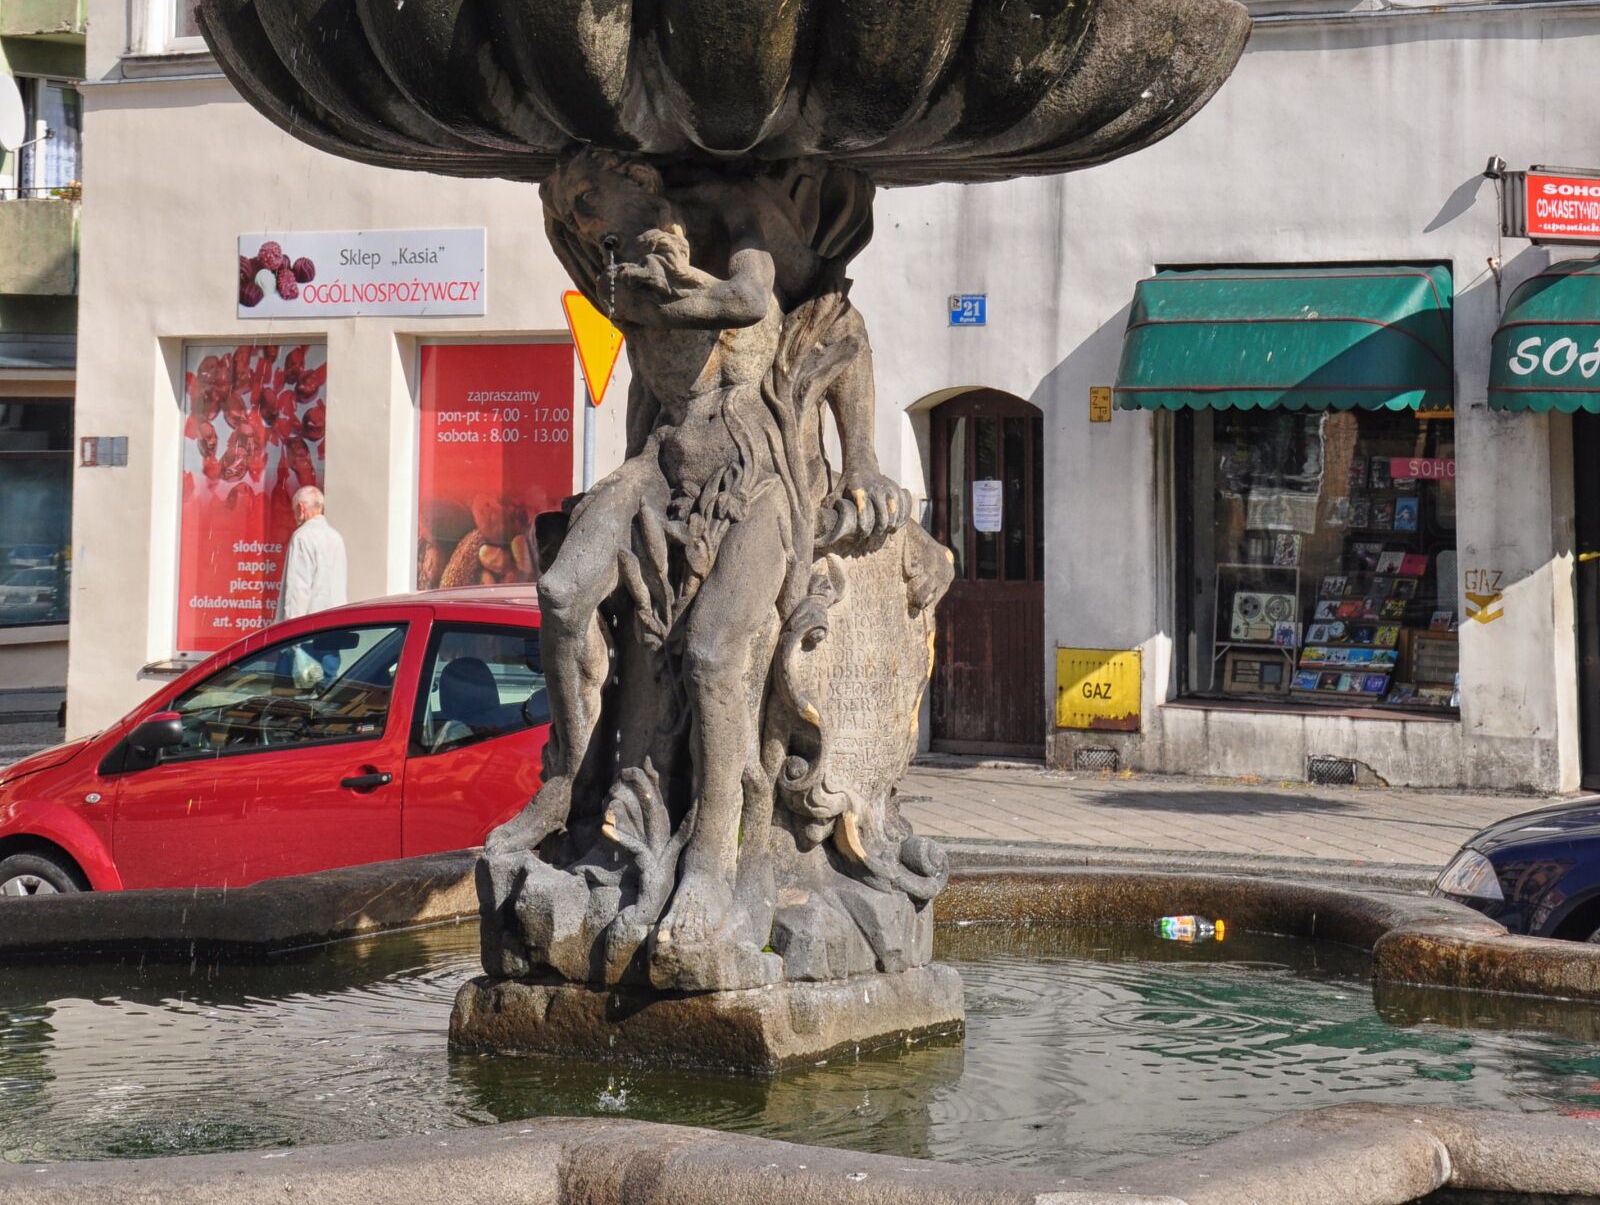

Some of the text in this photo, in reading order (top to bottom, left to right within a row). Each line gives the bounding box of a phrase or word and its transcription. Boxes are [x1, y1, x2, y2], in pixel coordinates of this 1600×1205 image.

[339, 248, 381, 269] Sklep
[303, 278, 480, 304] OGÓLNOSPOŻYWCZY
[963, 300, 980, 317] 21
[467, 390, 540, 405] zapraszamy
[437, 410, 480, 426] pon-pt
[491, 408, 520, 422] 7.00
[534, 408, 570, 422] 17.00
[437, 428, 479, 442] sobota
[490, 428, 519, 443] 8.00
[533, 428, 569, 443] 13.00
[237, 560, 277, 574] napoje
[1464, 569, 1504, 592] GAZ
[212, 617, 232, 627] art.
[1082, 682, 1112, 700] GAZ
